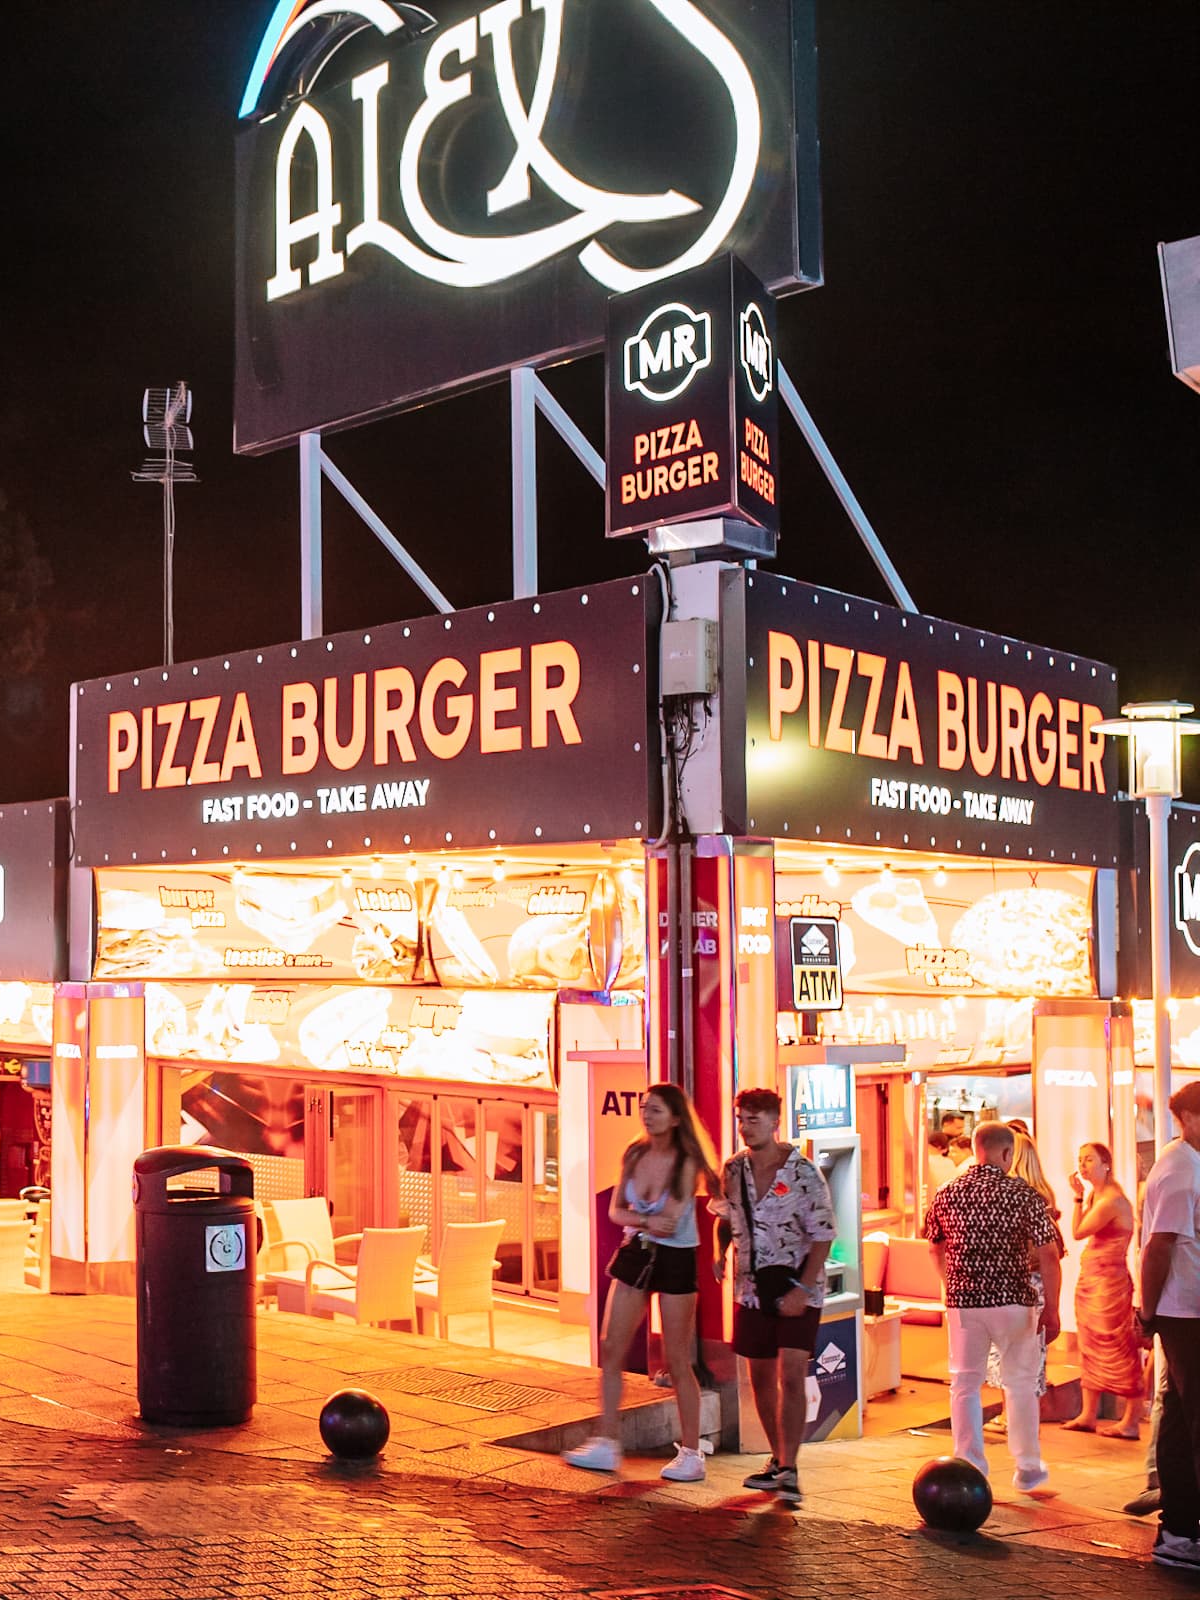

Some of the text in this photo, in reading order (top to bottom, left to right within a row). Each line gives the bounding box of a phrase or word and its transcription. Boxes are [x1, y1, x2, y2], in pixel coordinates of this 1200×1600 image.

[637, 322, 697, 381] MR
[743, 322, 768, 379] MR
[634, 419, 703, 466] PIZZA
[744, 417, 770, 465] PIZZA
[621, 452, 719, 505] BURGER
[740, 450, 775, 505] BURGER
[108, 640, 583, 794] PIZZA BURGER
[768, 630, 1107, 794] PIZZA BURGER
[203, 796, 244, 824] FAST
[246, 793, 299, 819] FOOD
[317, 785, 367, 814] TAKE
[371, 779, 430, 809] AWAY
[871, 777, 908, 810] FAST
[910, 782, 951, 816] FOOD
[963, 790, 997, 821] TAKE
[998, 796, 1034, 826] AWAY
[159, 886, 214, 909] burger
[191, 907, 226, 929] pizza
[356, 888, 412, 912] kebab
[527, 886, 587, 915] chicken
[224, 947, 285, 967] toasties
[739, 934, 771, 954] FOOD
[800, 971, 837, 1001] ATM
[601, 1091, 645, 1116] AT
[795, 1069, 846, 1110] ATM
